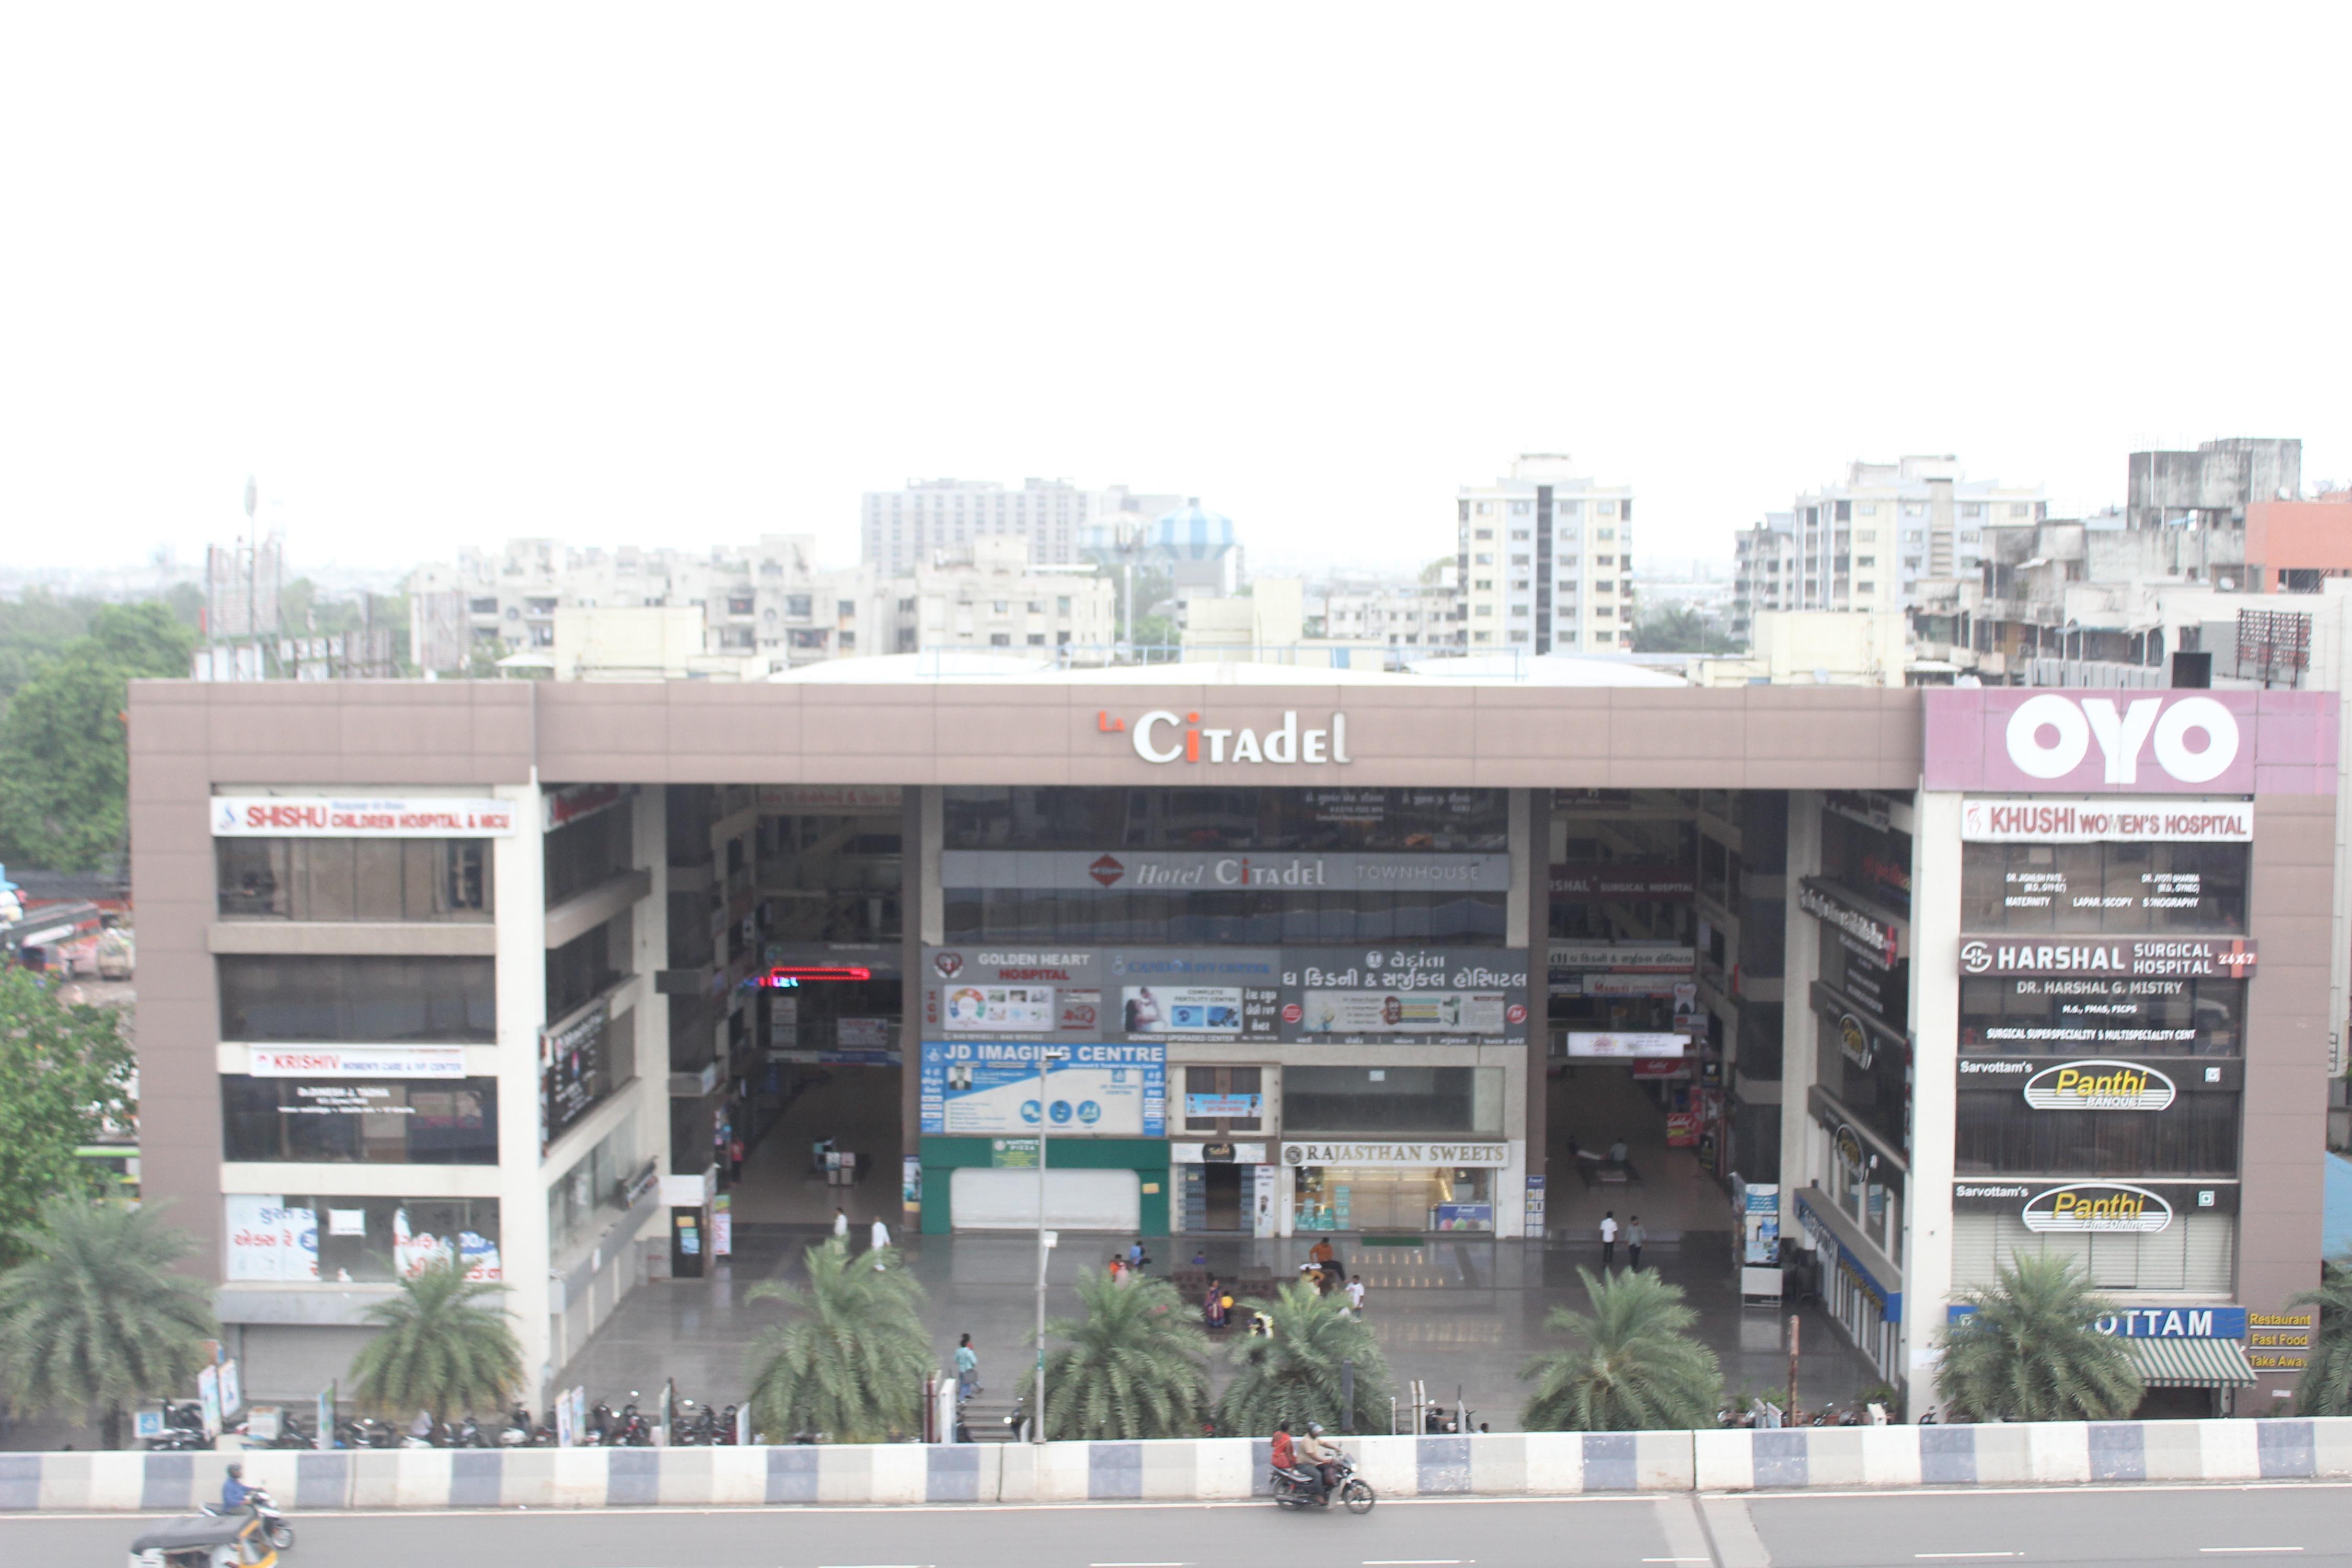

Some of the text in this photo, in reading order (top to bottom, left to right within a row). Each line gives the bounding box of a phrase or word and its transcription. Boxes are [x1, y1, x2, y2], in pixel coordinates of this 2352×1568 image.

[2005, 694, 2240, 784] OYO
[247, 806, 327, 828] SHISHU
[332, 814, 395, 829] CHILDREN
[399, 814, 462, 829] HOSPITAL
[1990, 807, 2246, 835] KHUSHI WOMEN'S HOSPITAL
[1137, 863, 1204, 884] Hotel
[1356, 865, 1480, 880] TOWNHOUSE
[2005, 896, 2051, 907] MATERNITY
[1997, 946, 2126, 971] HARSHAL
[2132, 942, 2213, 959] SURGICAL
[978, 953, 1090, 966] GOLDEN HEART
[2133, 959, 2213, 975] HOSPITAL
[999, 969, 1070, 980] HOSPITAL
[1305, 966, 1359, 987] કિડની
[1364, 971, 1377, 987] &
[2016, 981, 2041, 994] DR.
[2045, 981, 2108, 994] HARSHAL
[2129, 981, 2183, 995] MISTRY
[1986, 1028, 2026, 1039] SURGICAL
[944, 1045, 1164, 1062] JD IMAGING CENTRE
[273, 1054, 340, 1070] KRISHIV
[1960, 1060, 2033, 1074] Sarvottam's
[2054, 1069, 2149, 1097] Panthi
[2085, 1097, 2142, 1107] BANQUET
[1307, 1145, 1505, 1165] RAJASTHAN SWEETS
[1956, 1185, 2028, 1198] Sarvottam's
[2051, 1192, 2145, 1219] Panthi
[2077, 1309, 2213, 1336] OTTAM
[2250, 1312, 2312, 1325] Restaurant
[2252, 1333, 2309, 1346] Fast Food
[2249, 1355, 2276, 1367] Take
